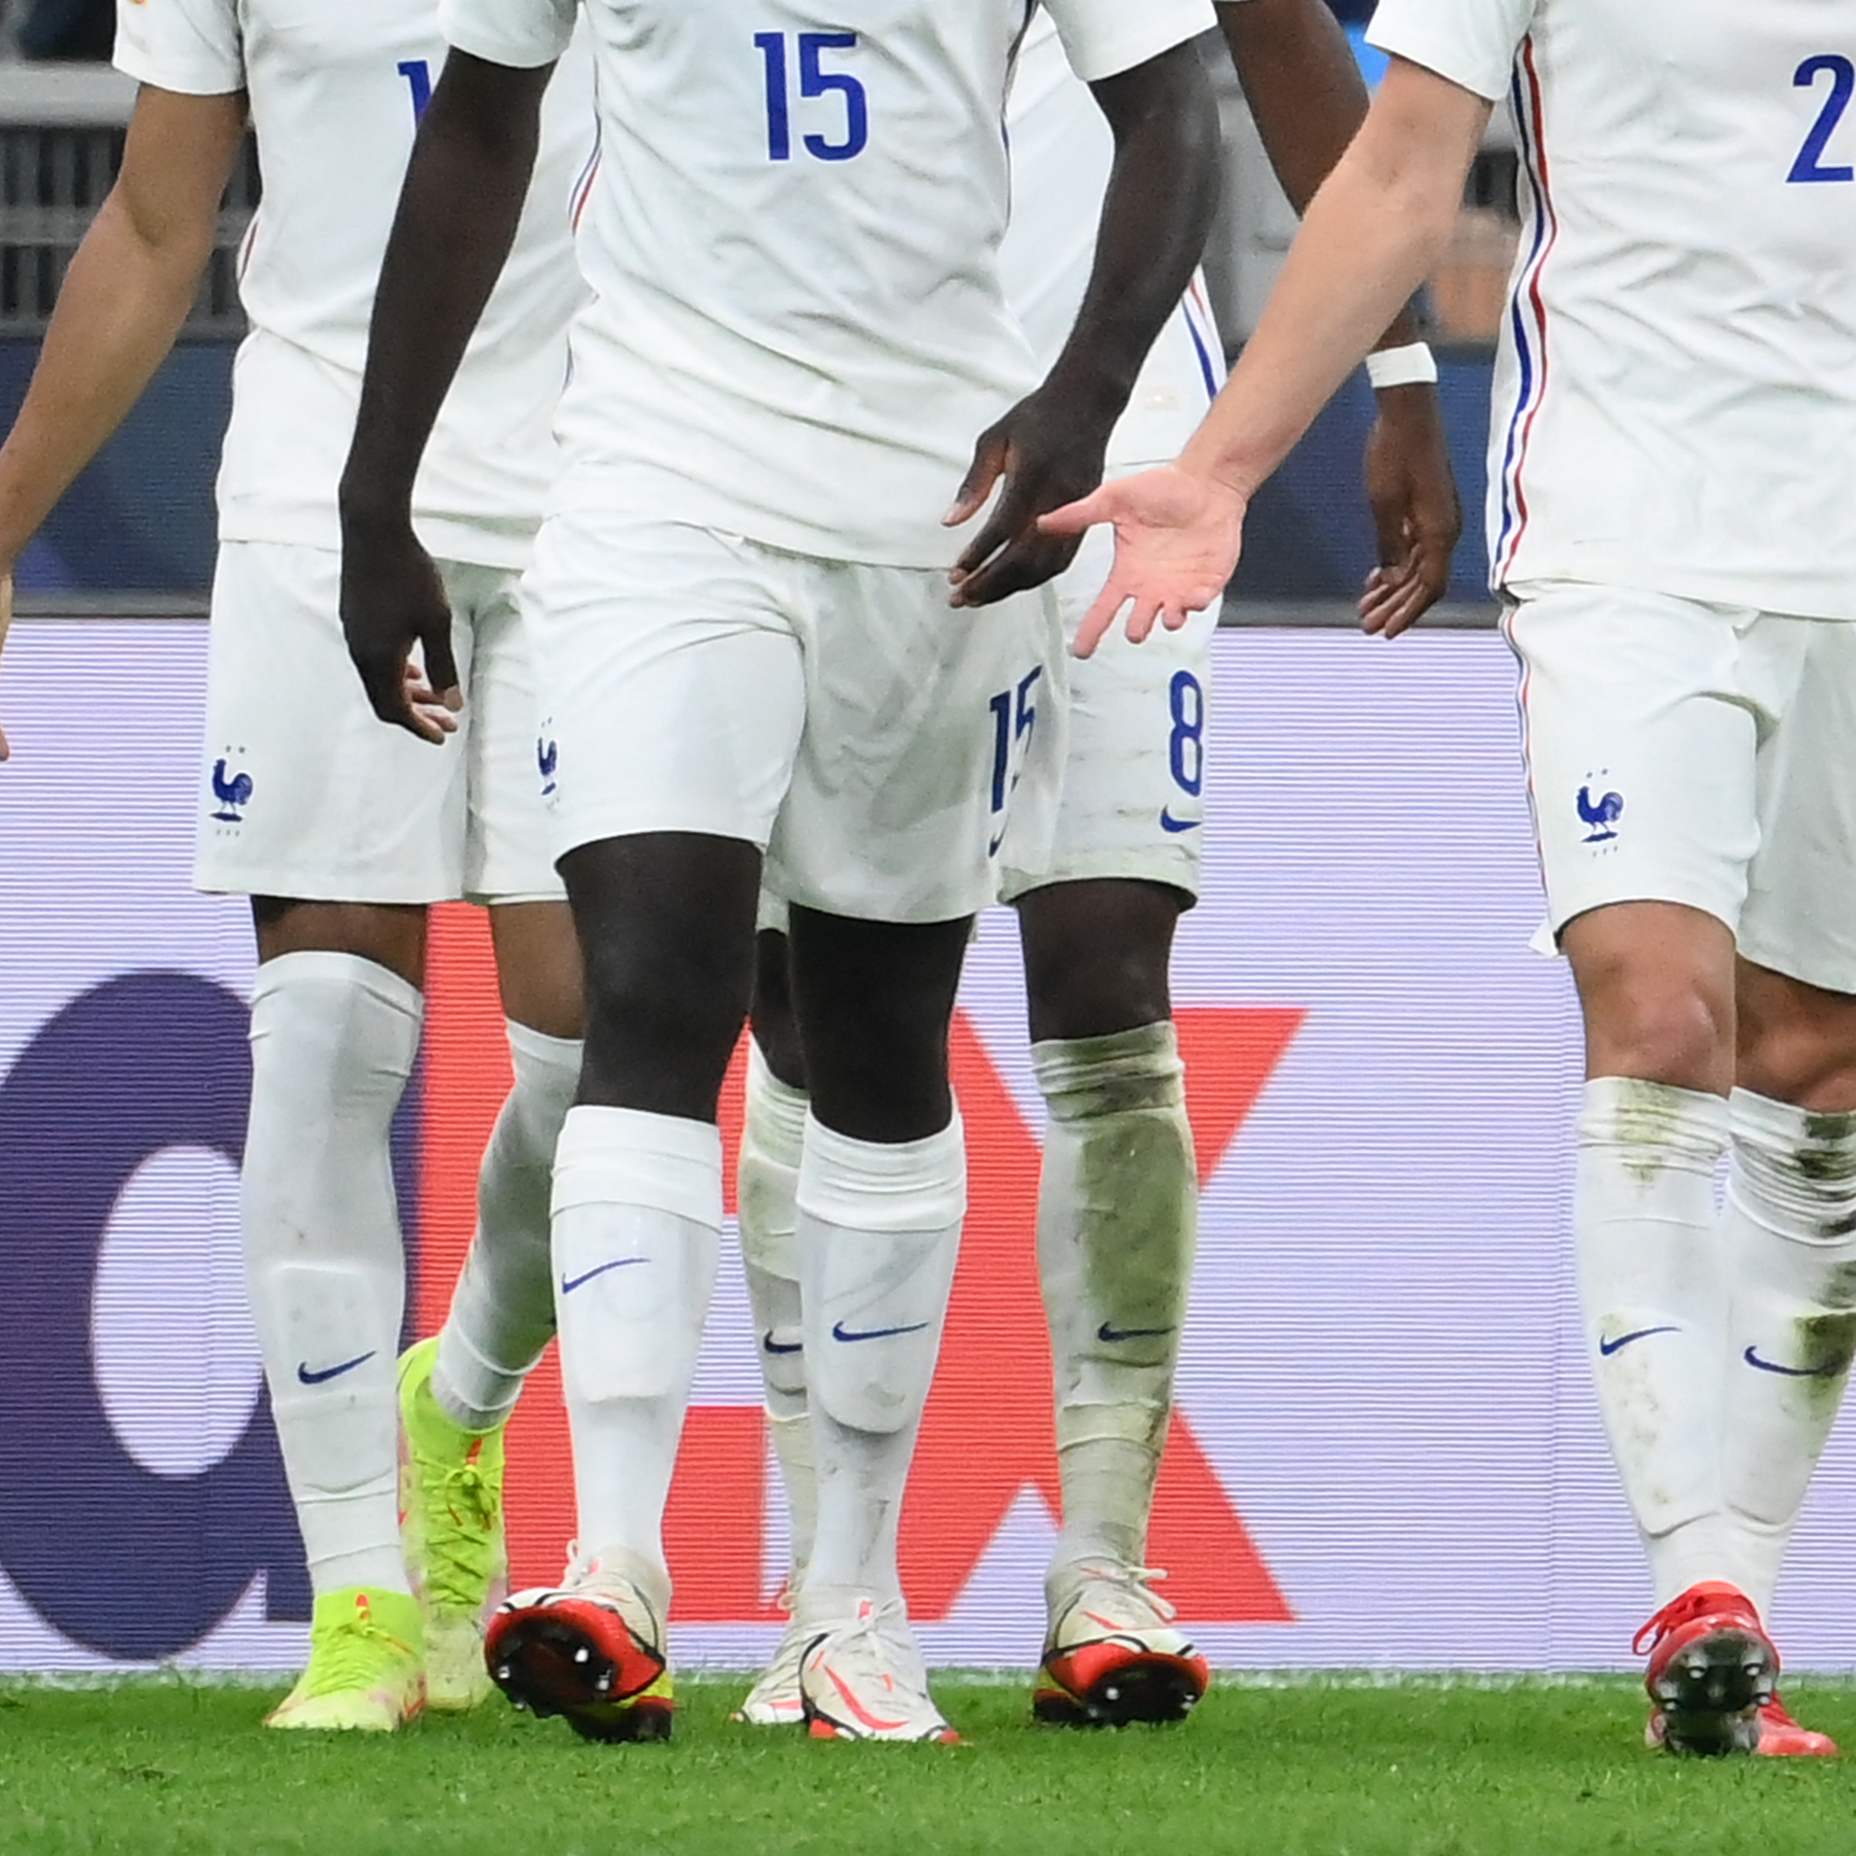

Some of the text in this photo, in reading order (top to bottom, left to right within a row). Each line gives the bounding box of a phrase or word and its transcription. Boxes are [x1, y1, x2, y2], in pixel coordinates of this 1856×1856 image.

[754, 32, 869, 161] 15
[1787, 55, 1855, 183] 2
[1169, 670, 1204, 797] 8
